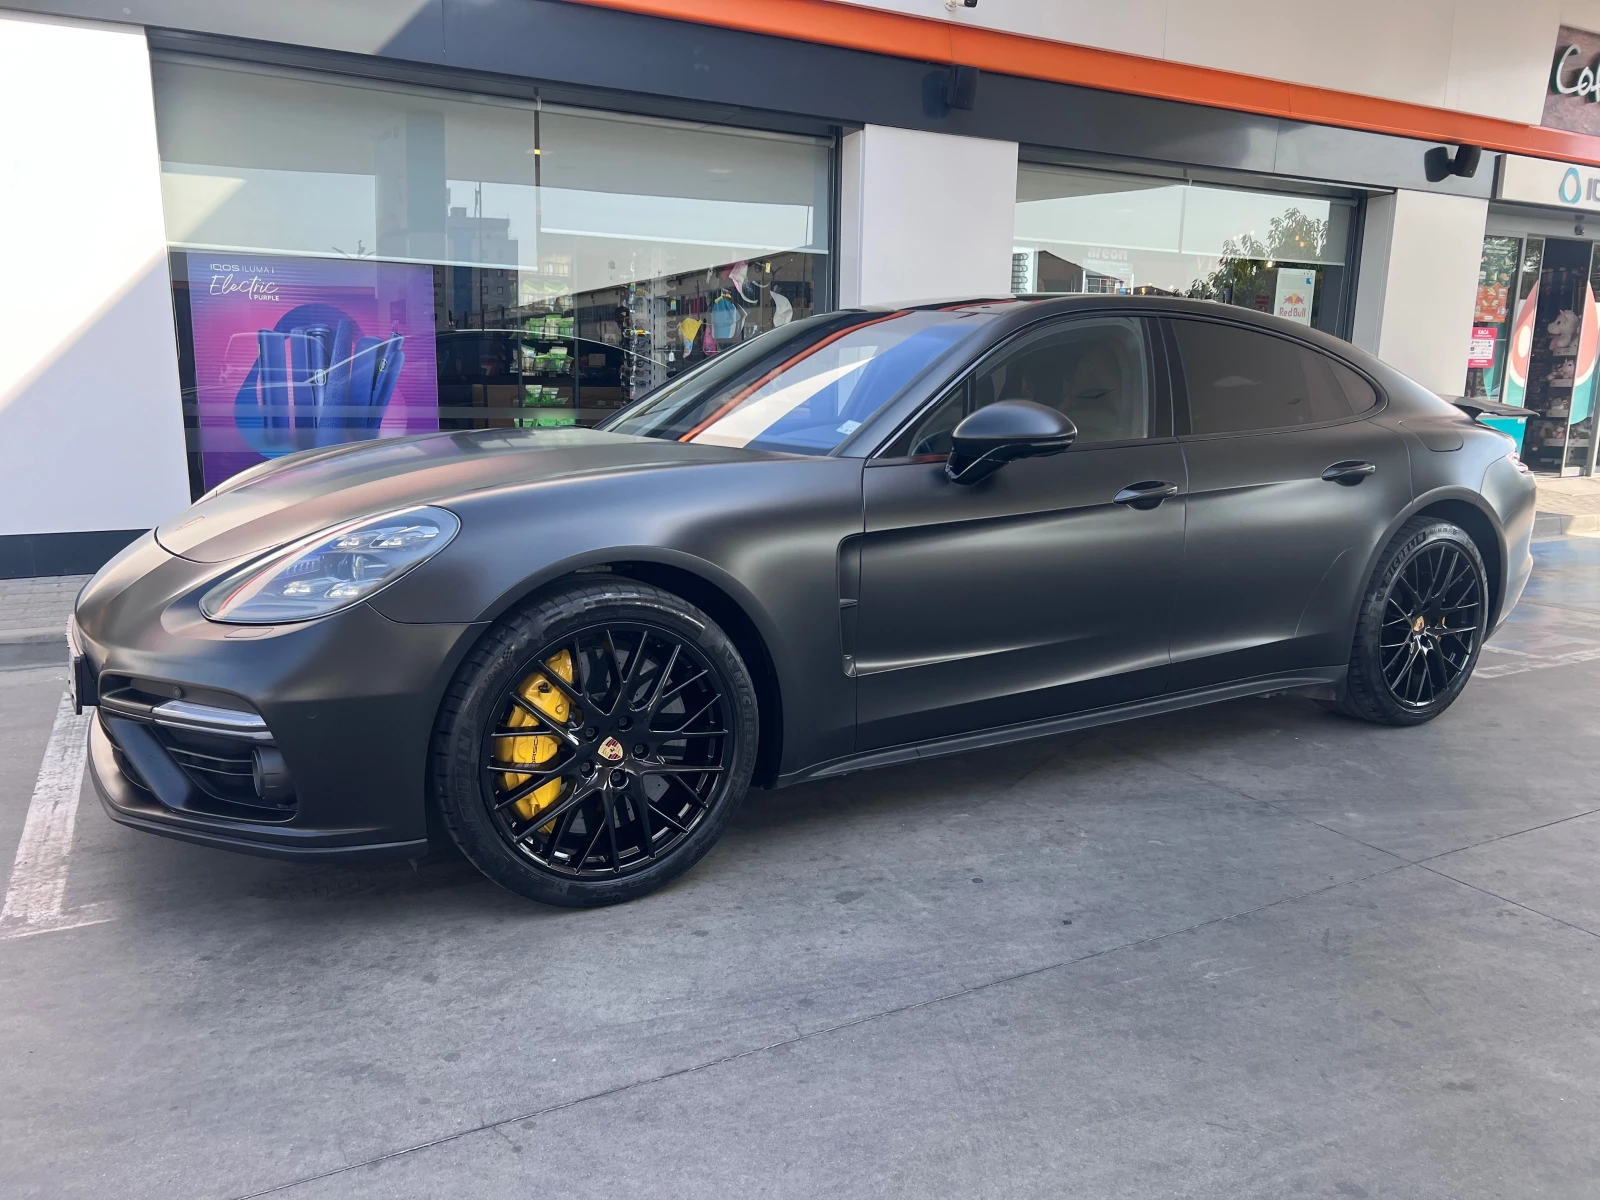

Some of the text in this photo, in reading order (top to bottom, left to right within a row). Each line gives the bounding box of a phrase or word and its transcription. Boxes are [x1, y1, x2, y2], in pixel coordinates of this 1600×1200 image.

[209, 263, 240, 272] IQOS
[241, 265, 270, 274] ILUMA
[209, 273, 279, 300] Electric
[253, 294, 280, 302] PURPLE
[1384, 532, 1424, 585] MICHELIN
